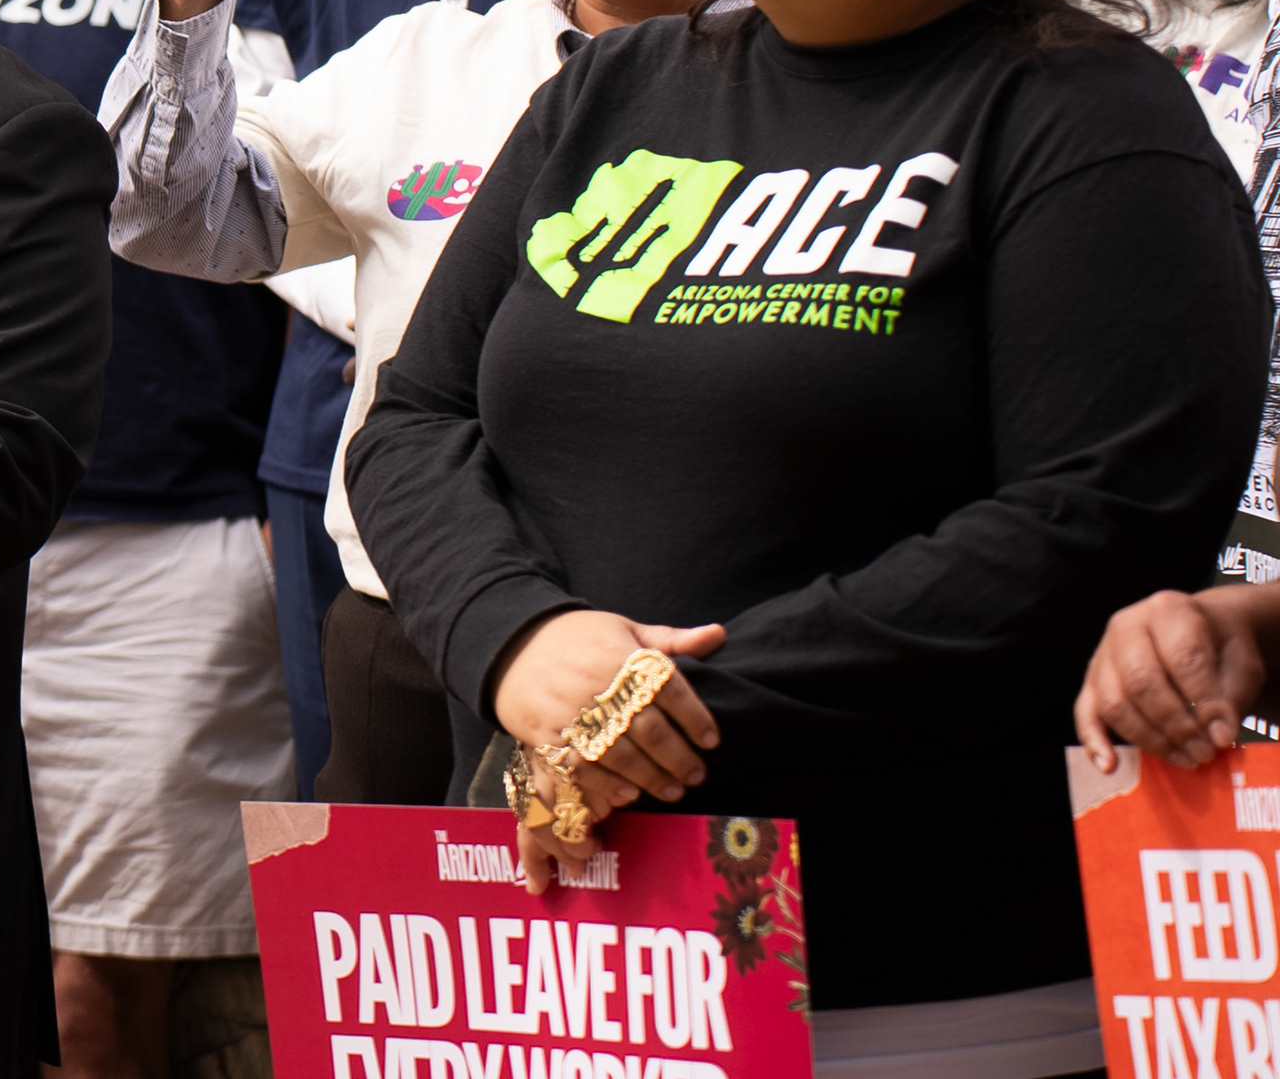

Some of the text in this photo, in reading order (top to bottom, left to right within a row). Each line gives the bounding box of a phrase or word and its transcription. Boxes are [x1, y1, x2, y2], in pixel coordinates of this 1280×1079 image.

[684, 151, 960, 277] ACE
[653, 301, 901, 336] EMPOWERMENT
[667, 283, 906, 307] ARIZONA CENTER FOR
[437, 843, 516, 883] ARIZONA
[1139, 849, 1278, 983] FEED
[313, 911, 733, 1052] PAID LEAVE FOR
[1113, 995, 1220, 1079] TAX
